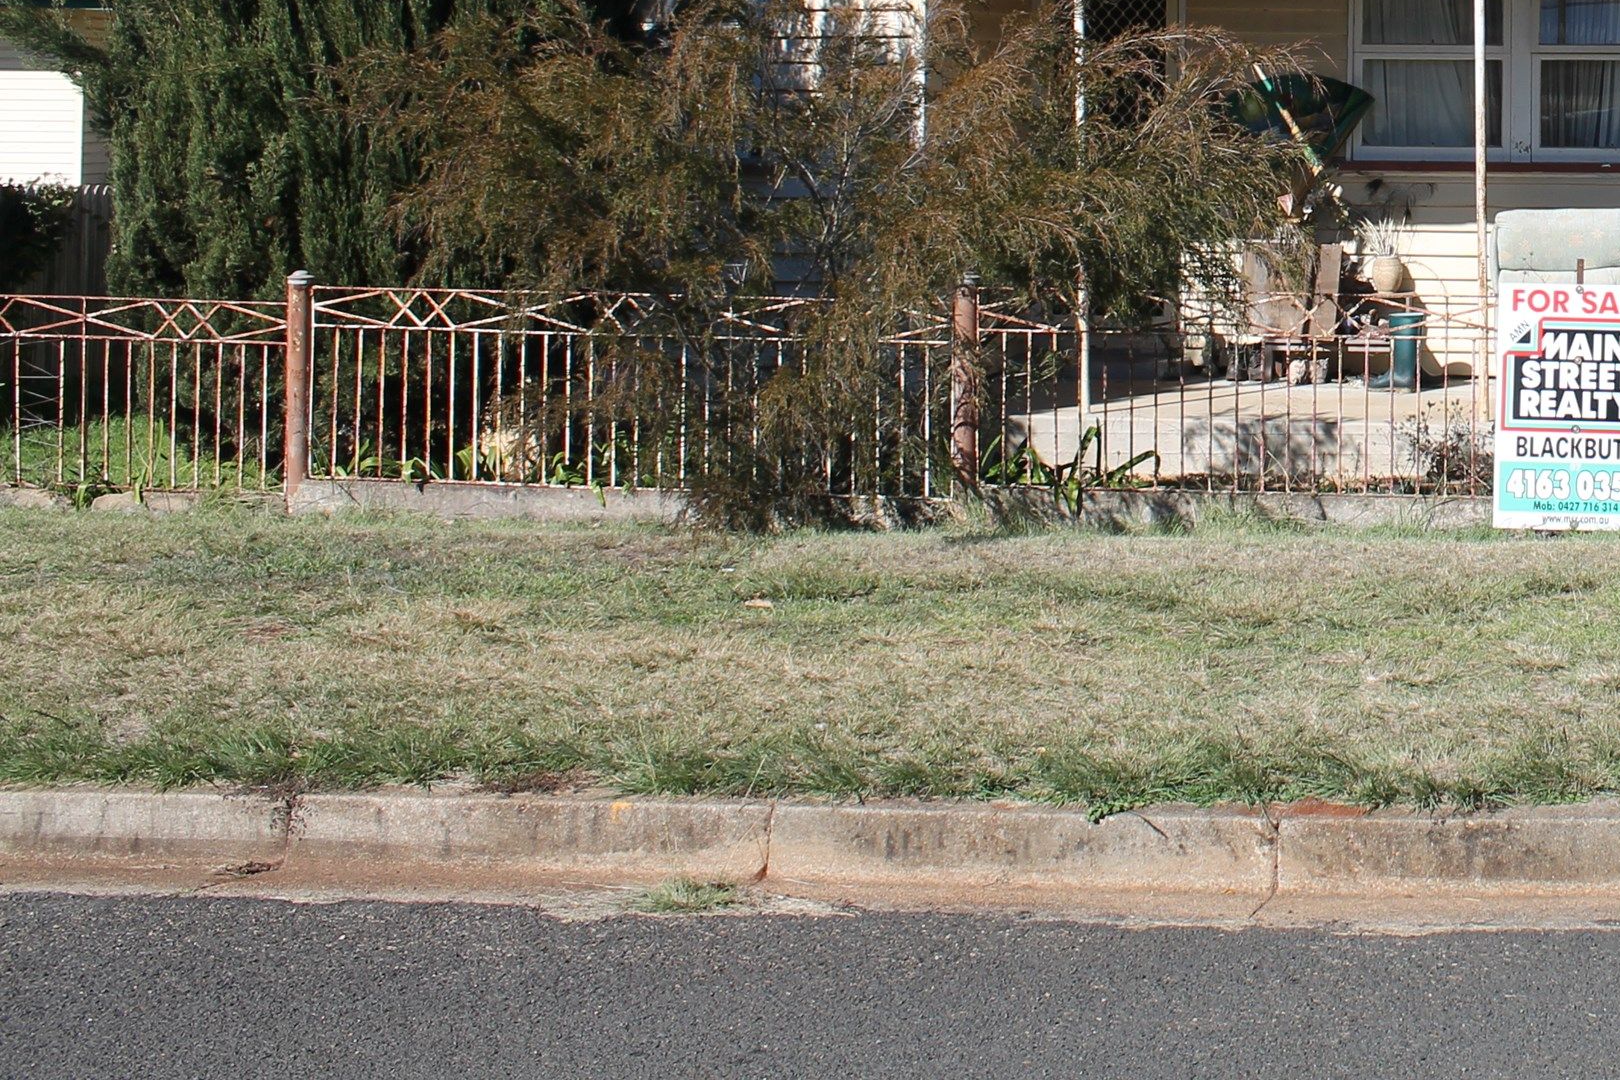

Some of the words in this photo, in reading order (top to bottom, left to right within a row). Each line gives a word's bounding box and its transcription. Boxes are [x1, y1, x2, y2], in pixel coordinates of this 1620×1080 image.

[1512, 289, 1570, 313] FOR
[1506, 468, 1571, 500] 4163
[1533, 500, 1555, 511] Mob:
[1558, 501, 1580, 511] 0427
[1583, 502, 1599, 512] 716
[1601, 502, 1618, 512] 314
